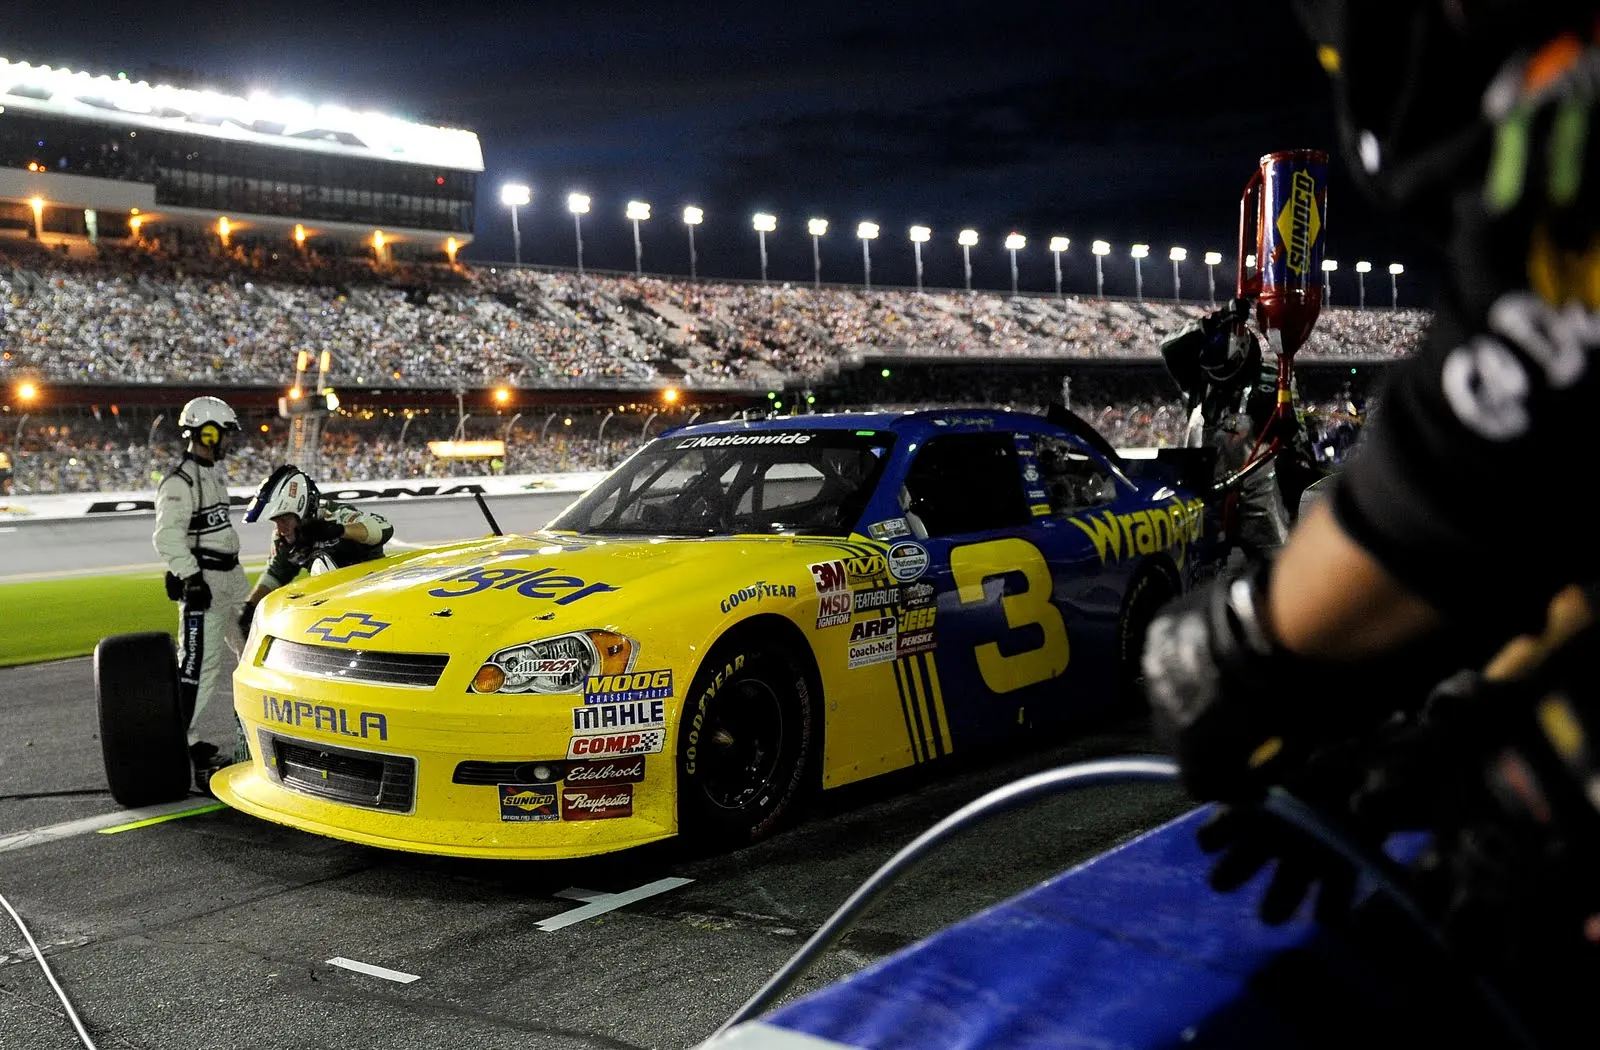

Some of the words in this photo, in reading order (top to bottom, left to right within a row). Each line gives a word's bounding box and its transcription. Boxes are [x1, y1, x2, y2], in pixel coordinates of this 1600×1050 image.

[1289, 174, 1314, 269] SUNOCO
[691, 432, 811, 449] Nationwide
[812, 560, 847, 593] 3M
[720, 581, 797, 614] GOODYEAR
[819, 594, 852, 618] MSD
[854, 587, 900, 610] FEATHERLITE
[907, 597, 930, 606] POLE
[818, 613, 850, 629] IGNITION
[898, 606, 937, 633] JEGS
[951, 538, 1070, 693] 3
[849, 619, 896, 642] ARP
[901, 632, 933, 648] PENSKE
[849, 641, 894, 660] Coach-Net
[585, 670, 671, 694] MOOG
[589, 691, 632, 704] CHASSIS
[263, 695, 388, 741] IMPALA
[574, 700, 664, 730] MAHLE
[686, 654, 745, 775] GOODYEAR
[572, 734, 642, 755] COMP
[619, 745, 652, 754] CAMS
[567, 761, 642, 781] Edelbrock
[504, 795, 554, 805] SUNOCO
[564, 792, 631, 813] Raybestos
